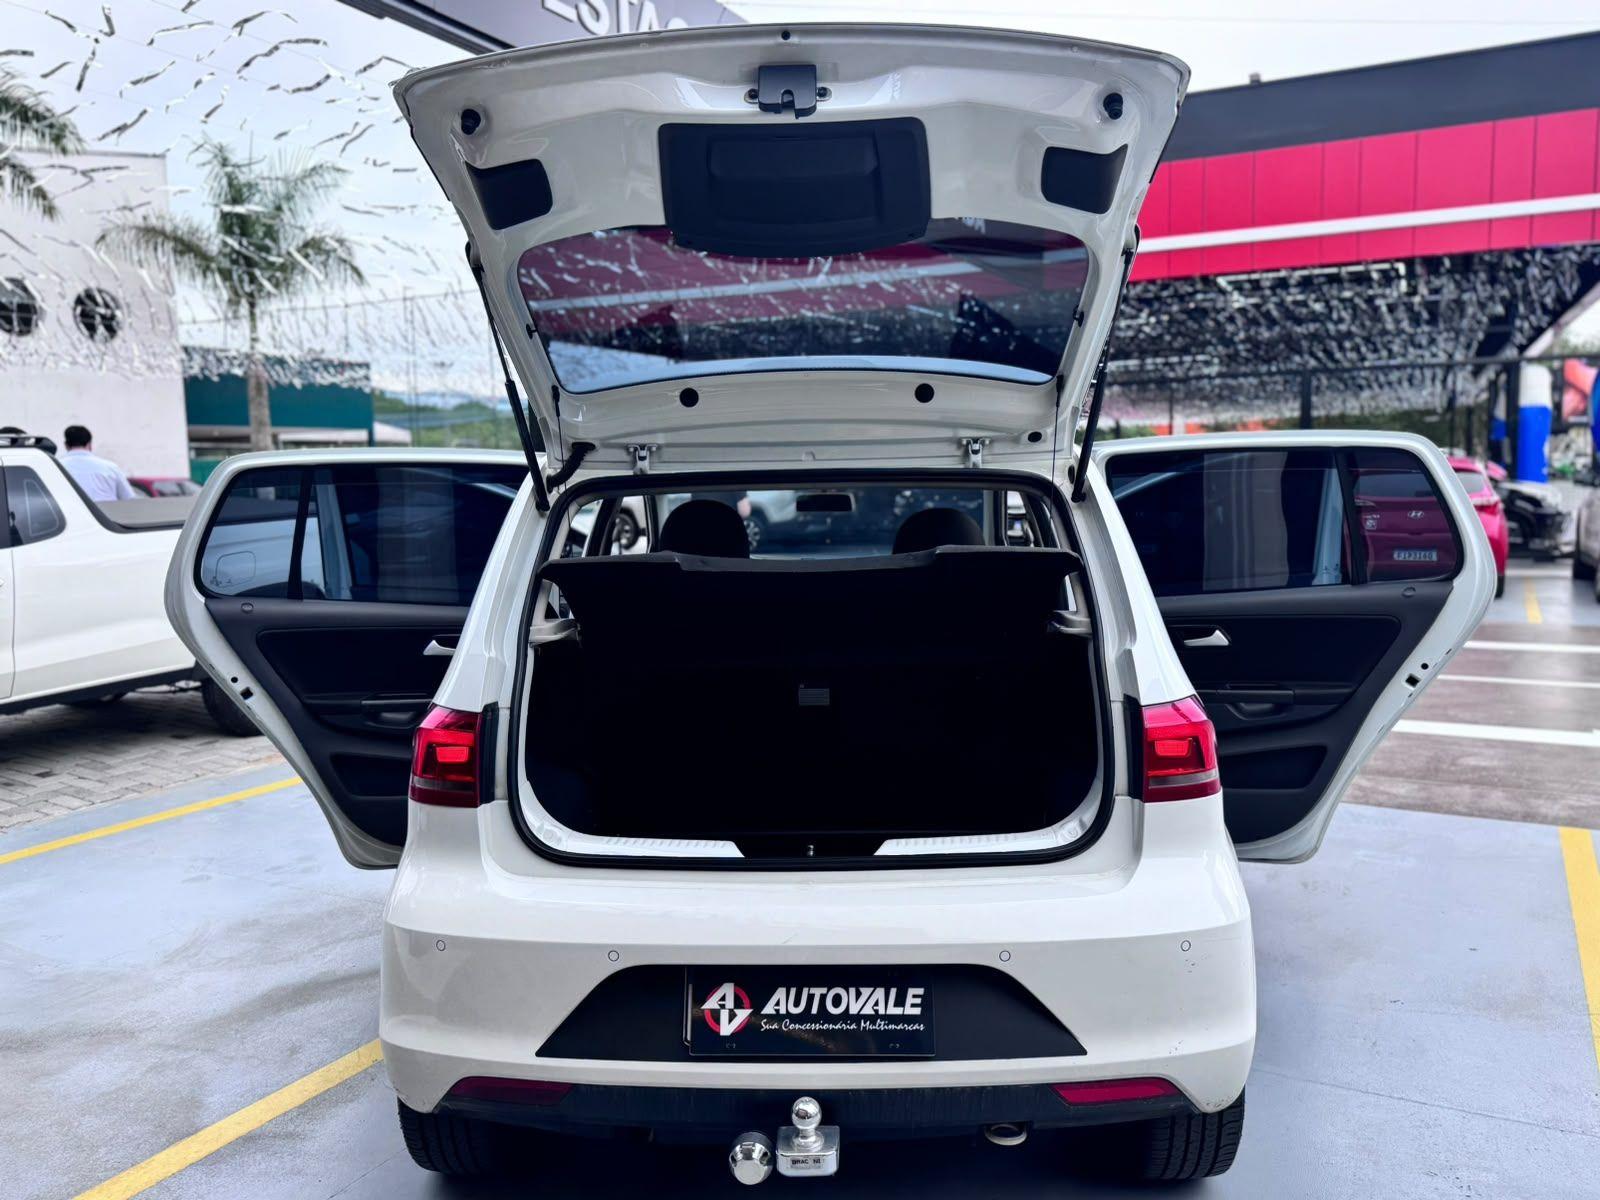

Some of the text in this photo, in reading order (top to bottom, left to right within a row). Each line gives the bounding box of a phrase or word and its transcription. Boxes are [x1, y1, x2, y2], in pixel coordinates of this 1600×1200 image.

[541, 0, 690, 36] STA
[760, 987, 925, 1015] AUTOVALE
[760, 1018, 925, 1032] Sua Concessionária Multimarcas
